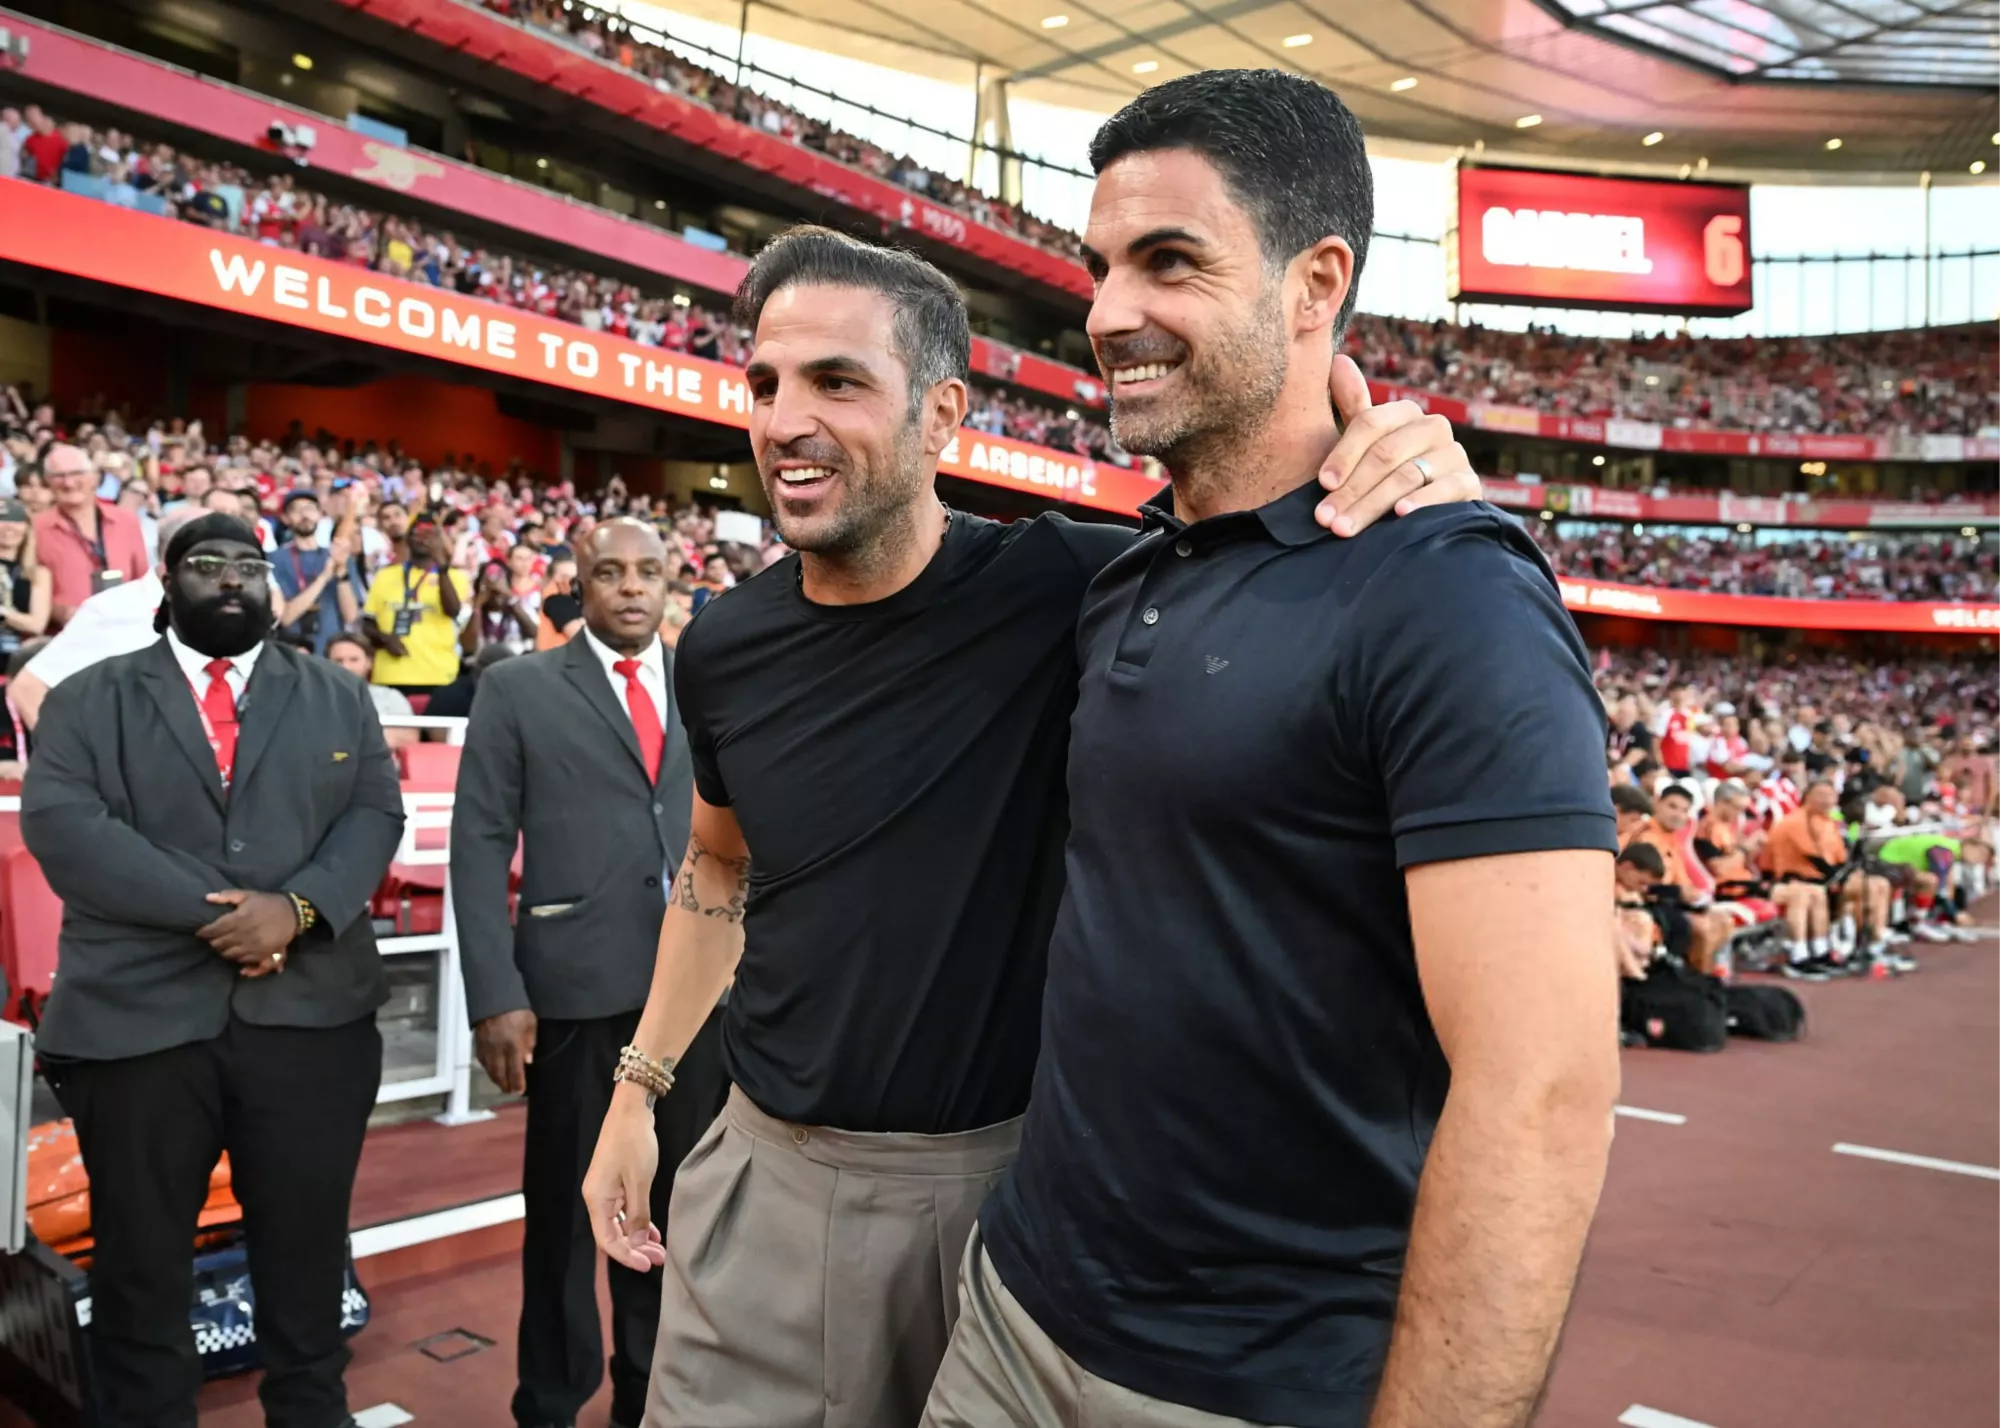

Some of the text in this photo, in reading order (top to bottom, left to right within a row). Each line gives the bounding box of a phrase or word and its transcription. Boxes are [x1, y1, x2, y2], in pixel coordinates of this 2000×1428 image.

[1703, 214, 1744, 286] 6
[209, 248, 517, 360] WELCOME
[537, 332, 599, 379] TO
[617, 352, 702, 404] THE
[718, 378, 754, 415] H
[969, 442, 1097, 497] ARSENAL
